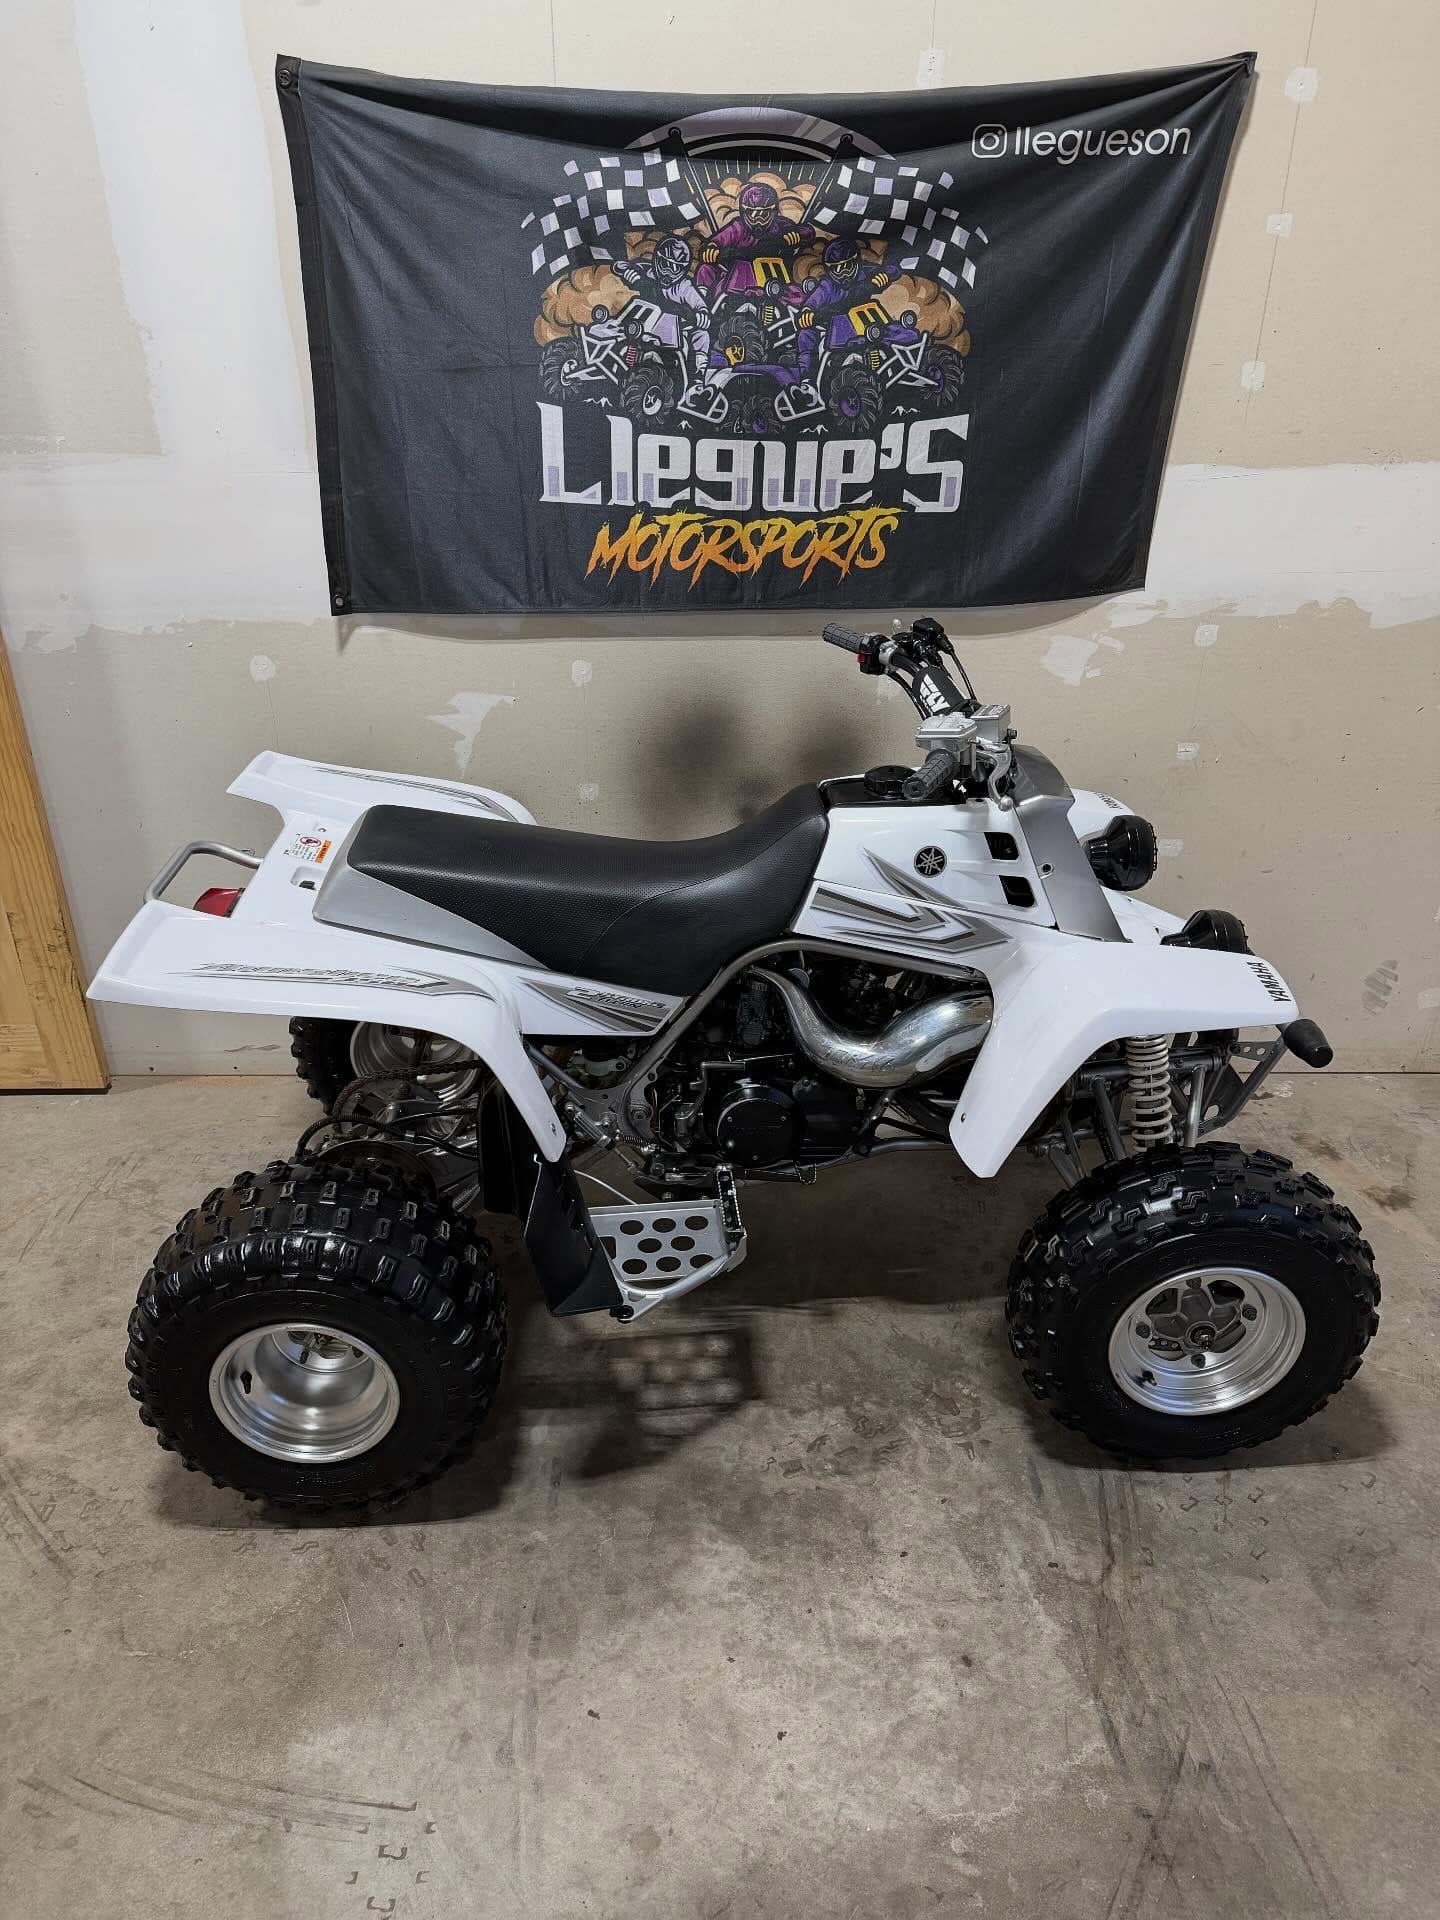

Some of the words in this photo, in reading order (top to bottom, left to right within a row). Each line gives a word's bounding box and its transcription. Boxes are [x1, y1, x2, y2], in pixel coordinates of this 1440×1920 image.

[1014, 126, 1192, 165] llegueson
[584, 506, 909, 592] MOTORSPORTS
[1246, 961, 1292, 1003] YAMAHA
